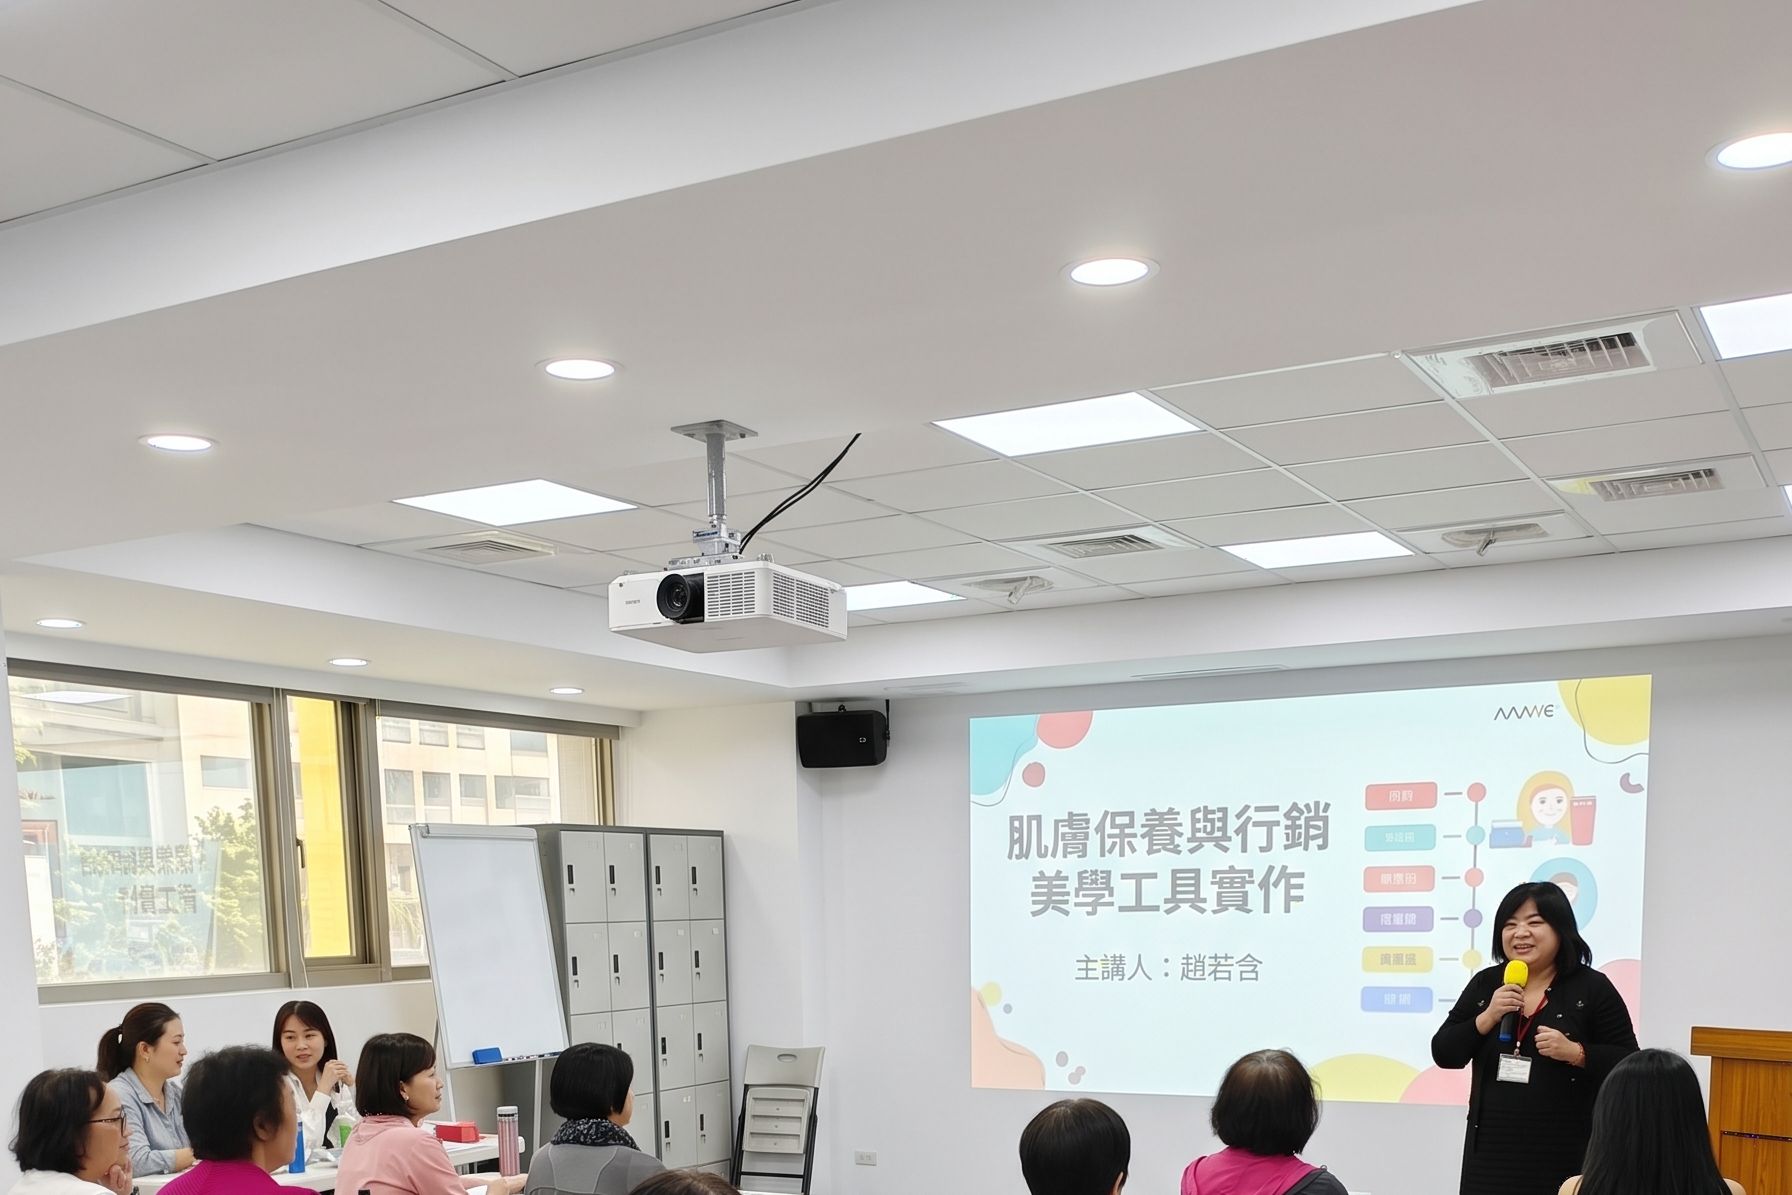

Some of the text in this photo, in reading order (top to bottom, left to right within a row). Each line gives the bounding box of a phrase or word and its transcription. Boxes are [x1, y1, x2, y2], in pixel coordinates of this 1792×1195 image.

[1007, 800, 1331, 861] 肌膚保養與行銷
[1030, 865, 1305, 917] 美學工具實作
[1075, 953, 1263, 982] 主講人：趙若含
